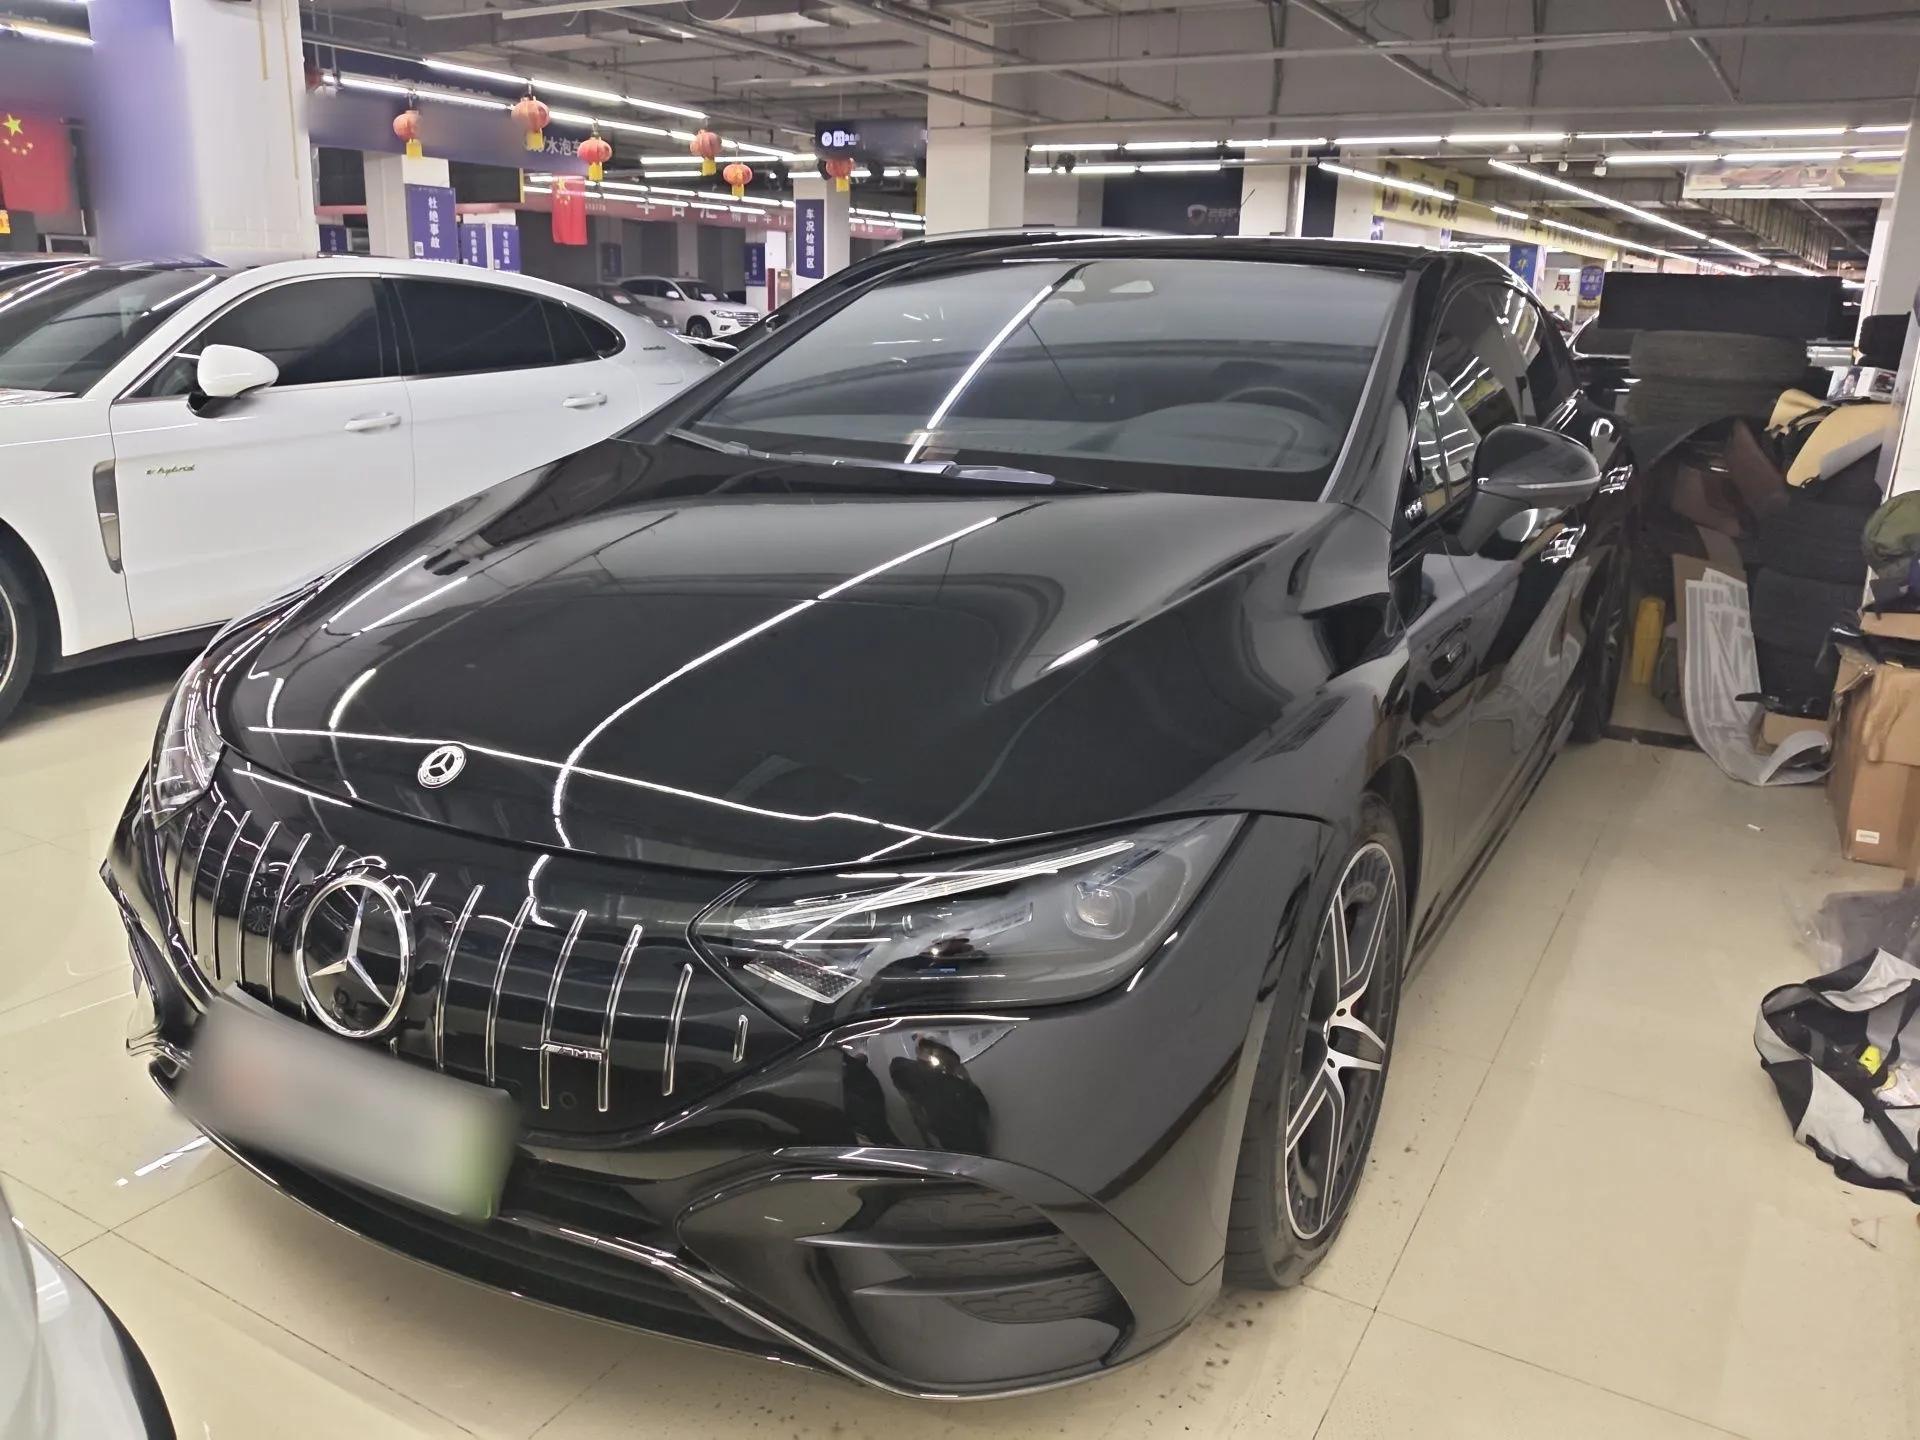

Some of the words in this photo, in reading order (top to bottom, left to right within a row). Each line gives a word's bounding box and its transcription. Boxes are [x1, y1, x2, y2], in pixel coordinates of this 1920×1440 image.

[428, 196, 440, 249] 杜绝事故
[805, 208, 815, 269] 车况检测区
